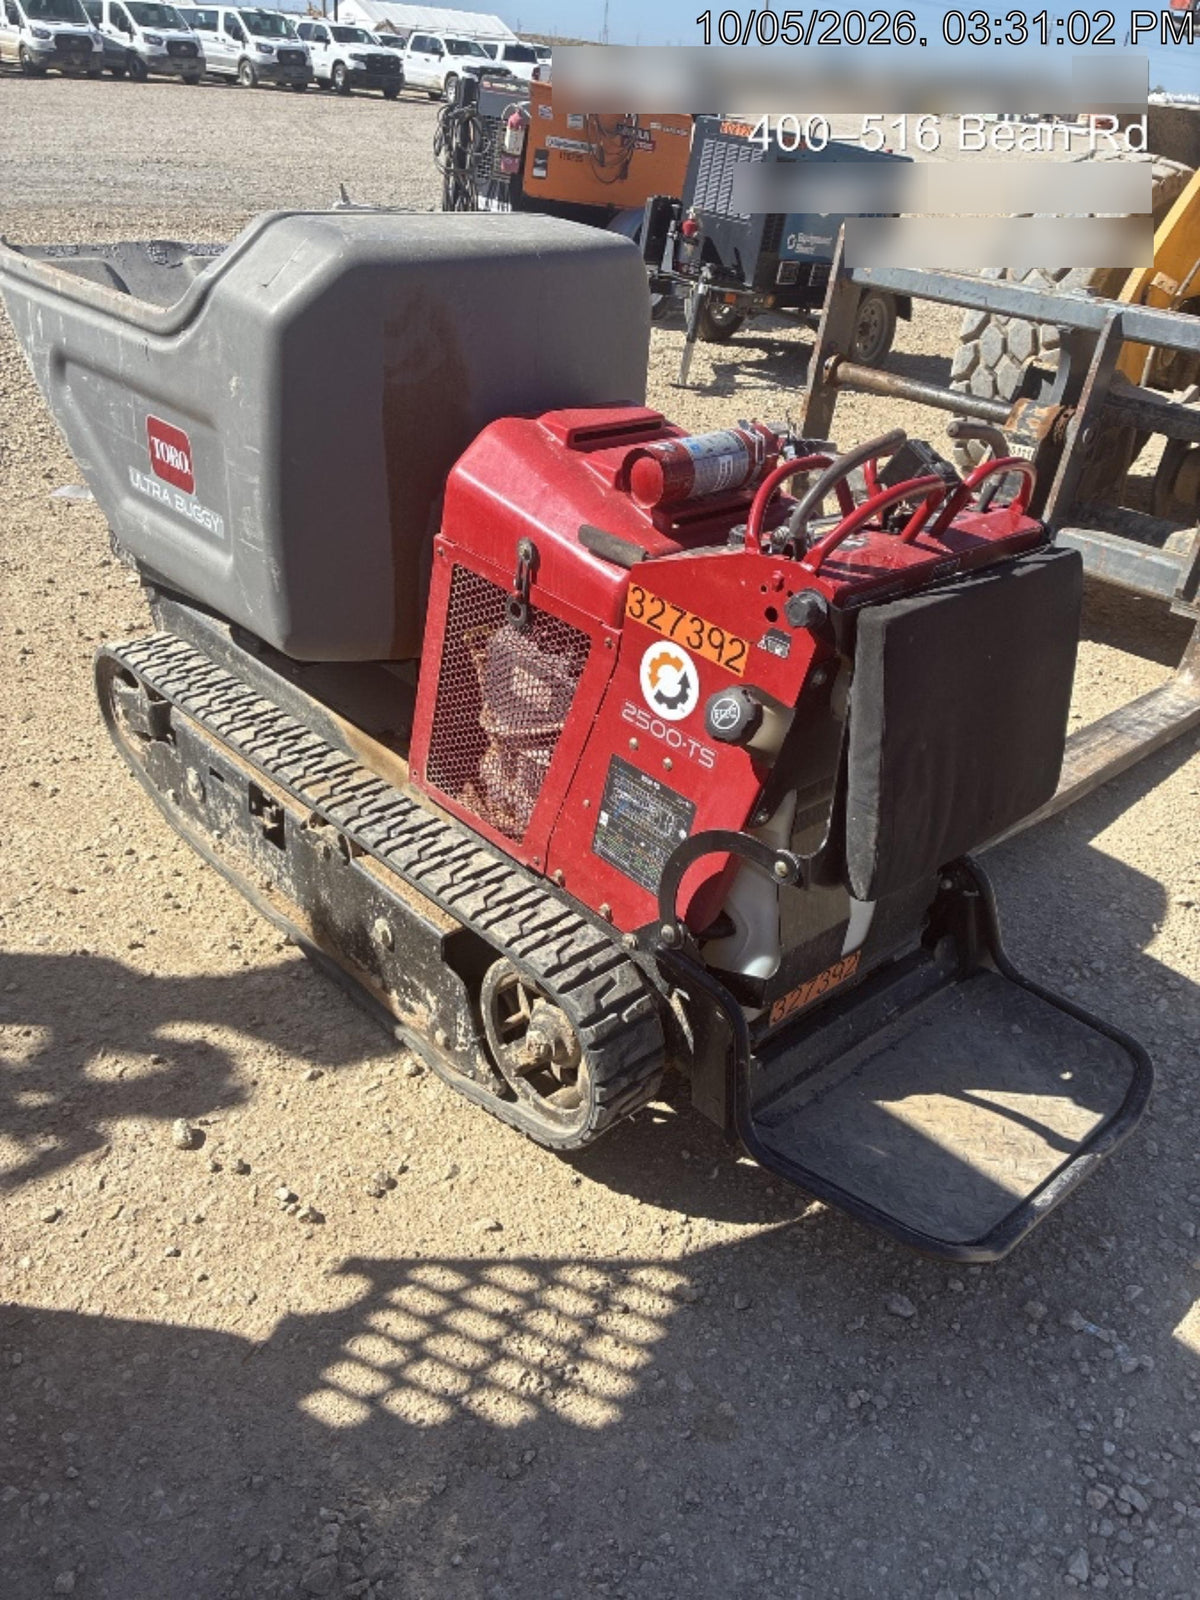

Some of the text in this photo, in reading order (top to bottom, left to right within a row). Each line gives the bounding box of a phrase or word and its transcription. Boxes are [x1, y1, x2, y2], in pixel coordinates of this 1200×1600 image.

[151, 436, 192, 475] TORO
[129, 466, 222, 534] ULTRA BUGGY
[628, 586, 747, 674] 327392
[771, 951, 859, 1023] 327392
